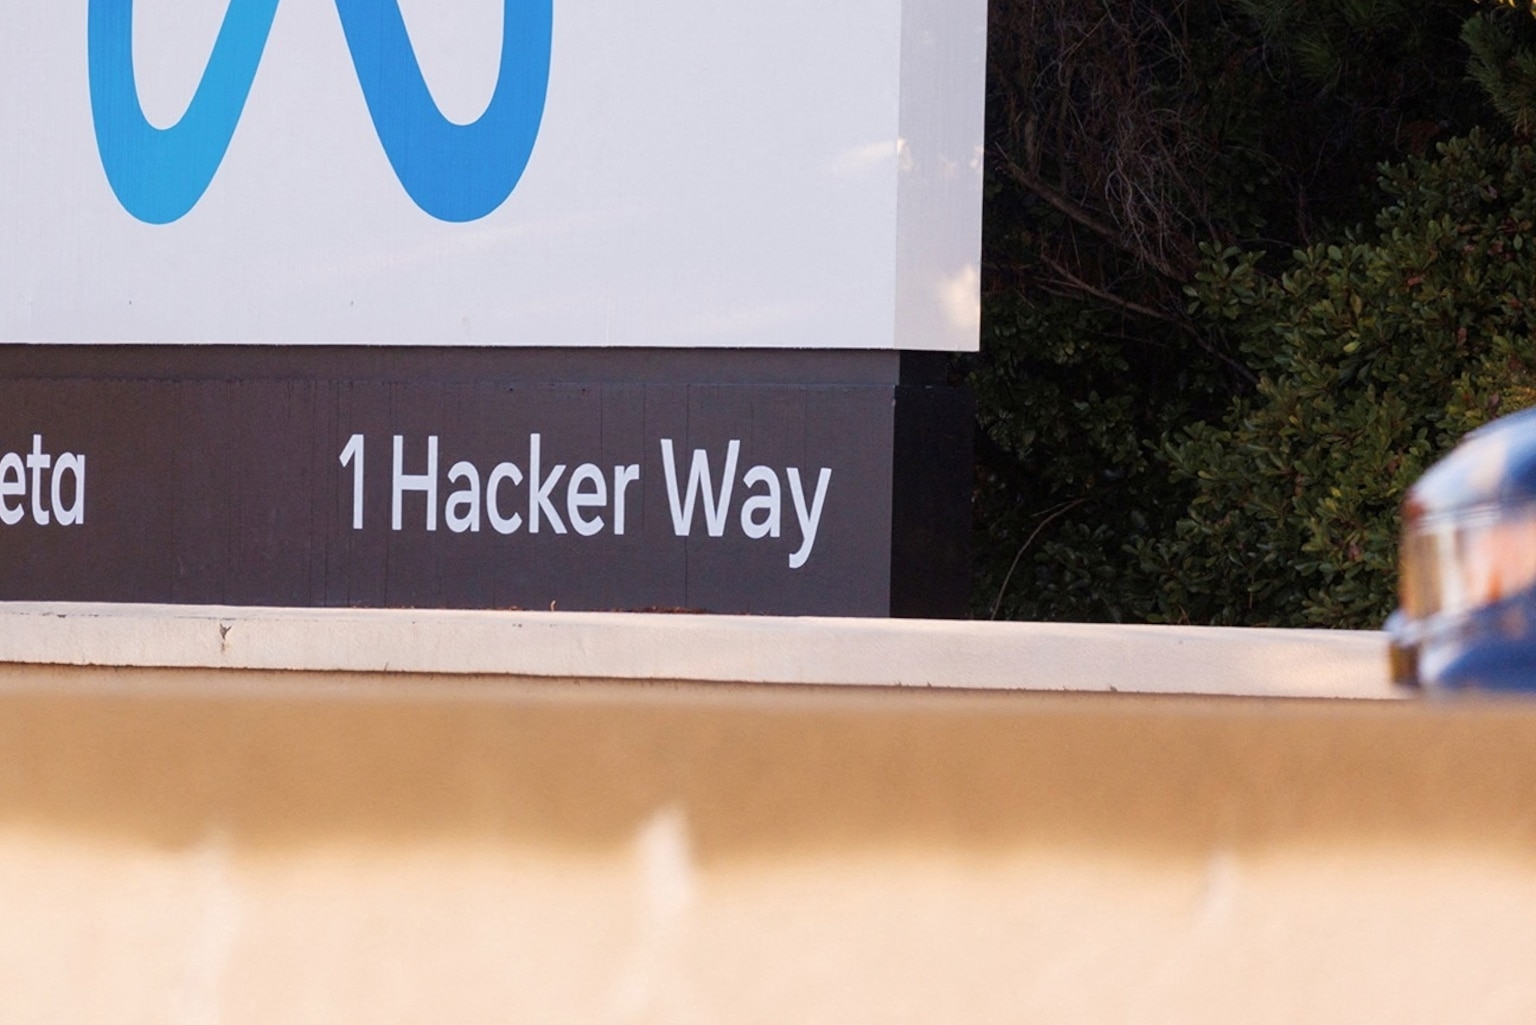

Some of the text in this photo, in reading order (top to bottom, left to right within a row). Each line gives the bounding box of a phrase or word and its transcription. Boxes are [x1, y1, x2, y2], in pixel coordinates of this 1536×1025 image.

[338, 432, 833, 569] 1 Hacker Way
